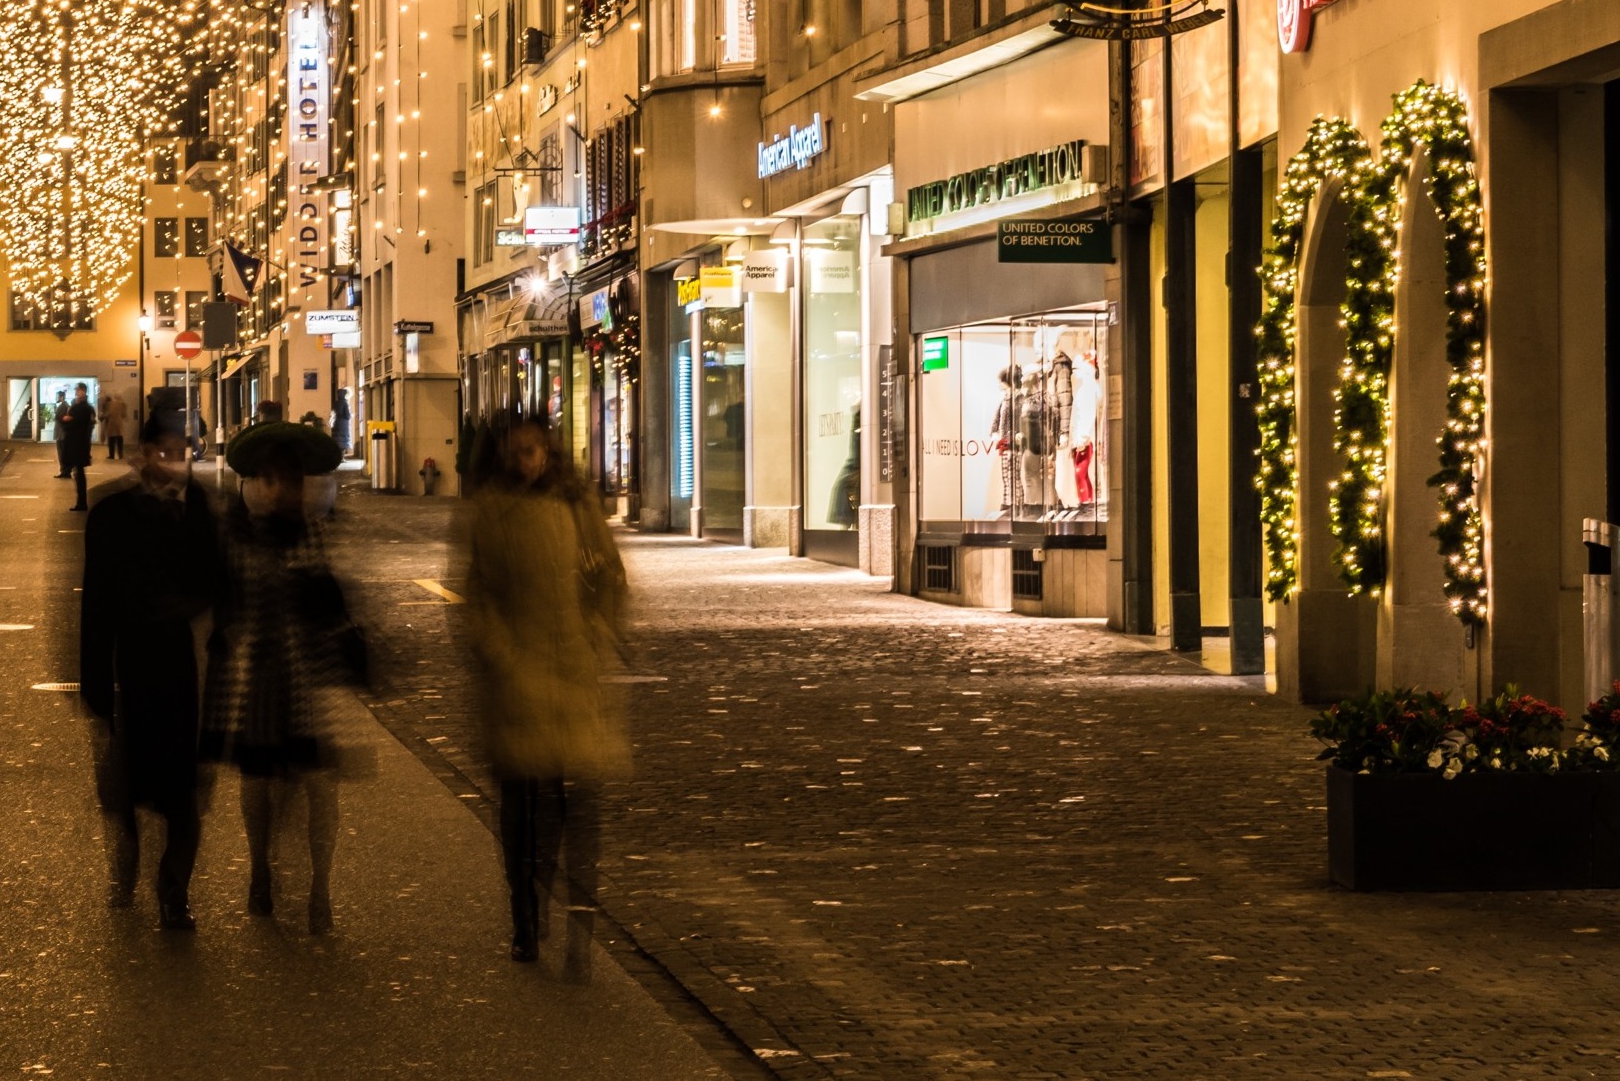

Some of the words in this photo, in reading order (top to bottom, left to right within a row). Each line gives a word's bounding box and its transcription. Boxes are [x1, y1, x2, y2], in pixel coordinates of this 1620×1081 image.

[1067, 25, 1113, 39] FRANZ
[1121, 27, 1158, 40] CARL
[299, 39, 318, 140] HOTEL
[758, 133, 791, 179] American
[790, 112, 823, 170] Apparel
[908, 180, 944, 223] UNITED
[1002, 223, 1045, 233] UNITED
[1047, 223, 1093, 234] COLORS
[1002, 236, 1018, 245] OF
[936, 439, 951, 456] NEED
